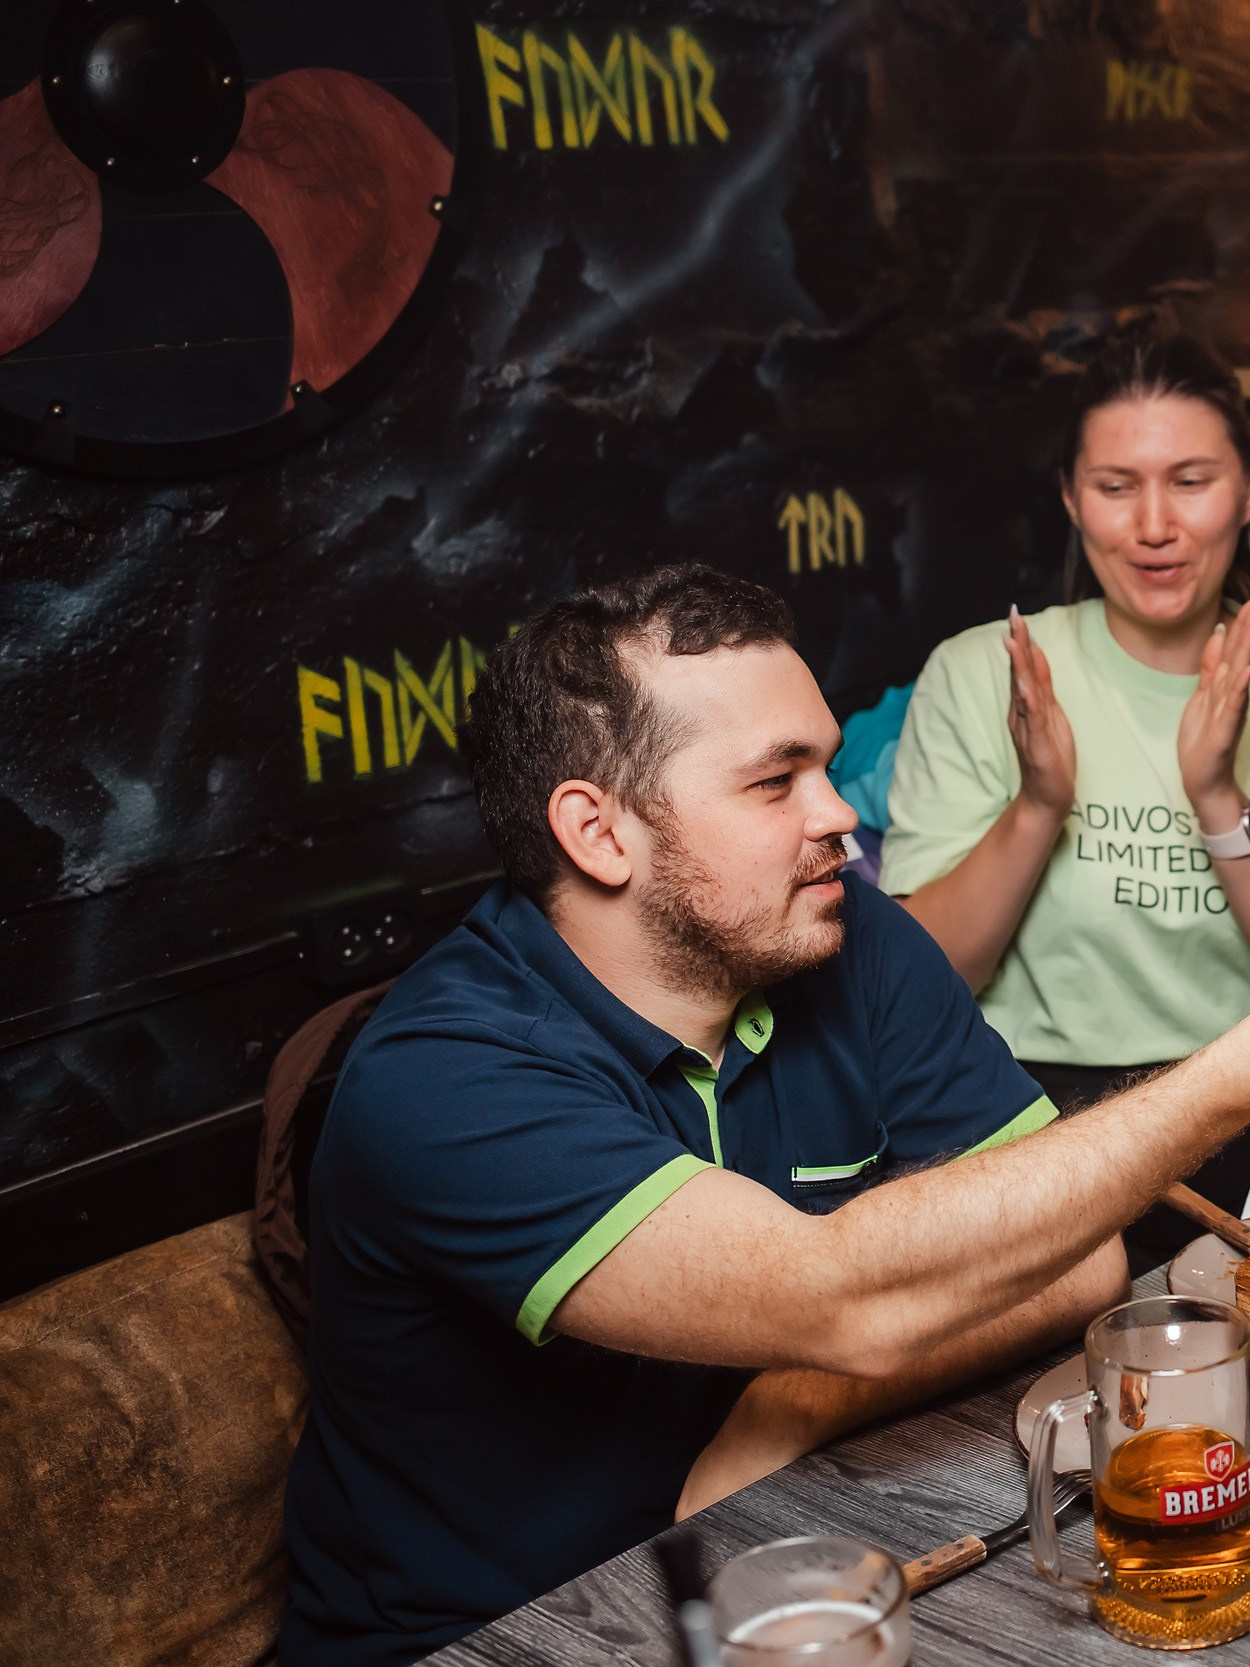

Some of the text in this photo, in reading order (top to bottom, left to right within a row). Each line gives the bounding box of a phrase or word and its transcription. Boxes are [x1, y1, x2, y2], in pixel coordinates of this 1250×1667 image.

[1071, 803, 1198, 836] DIVOS
[1077, 833, 1212, 873] LIMITED
[1114, 876, 1229, 914] EDITIO
